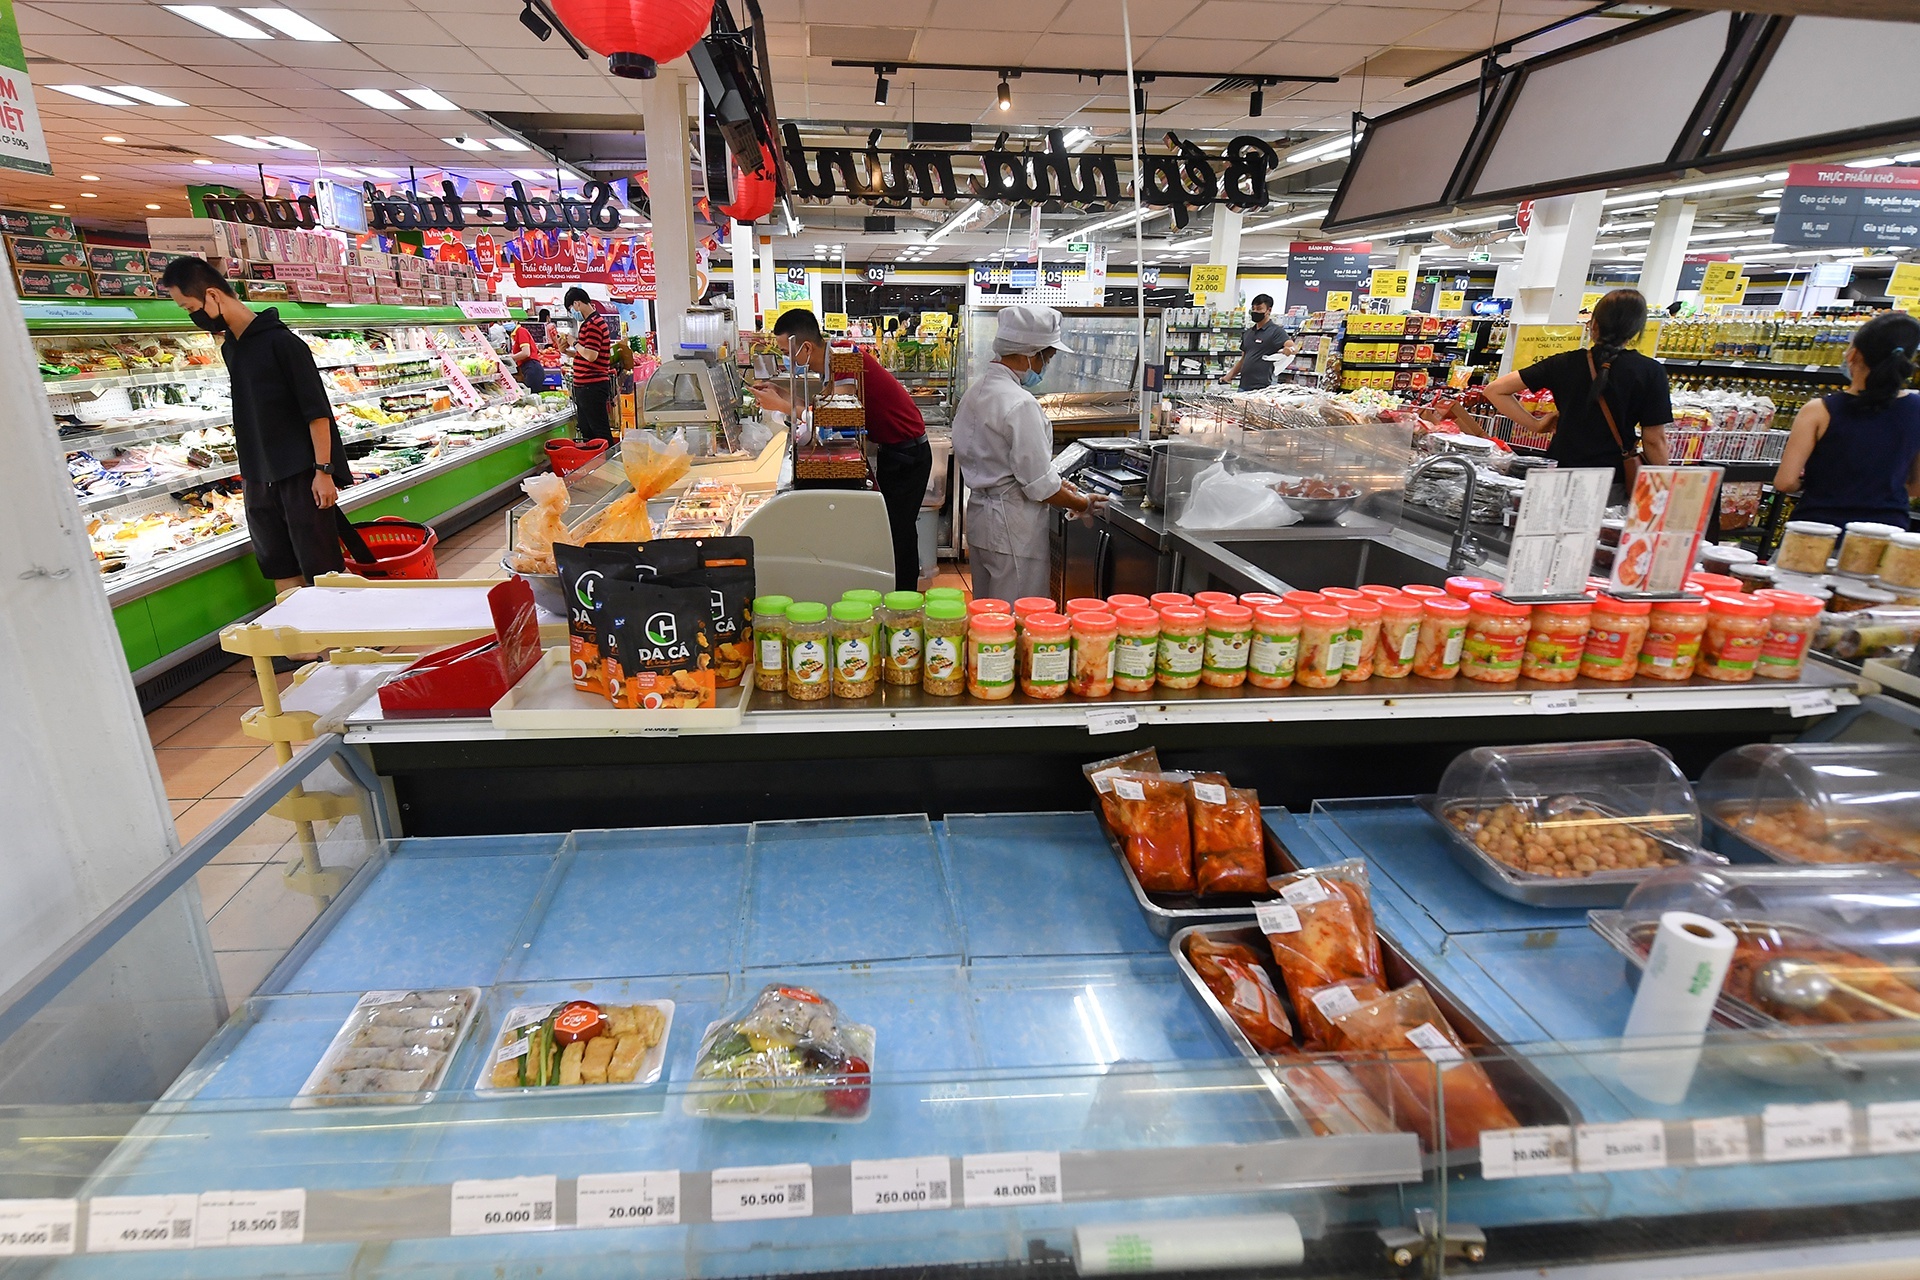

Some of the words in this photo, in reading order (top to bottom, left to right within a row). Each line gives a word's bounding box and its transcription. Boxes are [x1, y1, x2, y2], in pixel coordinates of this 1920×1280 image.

[12, 138, 28, 150] 500g
[755, 162, 776, 181] Su
[1818, 171, 1843, 184] THỰC
[1844, 170, 1871, 182] PHẨM
[1872, 172, 1894, 184] KHÔ
[1800, 195, 1816, 204] Gạo
[1817, 195, 1830, 204] các
[1831, 196, 1847, 206] loại
[521, 261, 536, 272] Trái
[539, 262, 553, 274] cây
[554, 264, 572, 272] New
[788, 268, 804, 279] 02
[868, 269, 884, 280] 03
[975, 272, 990, 282] 04
[1046, 272, 1062, 282] 05
[1143, 272, 1156, 284] 06
[1455, 279, 1468, 290] 10
[639, 648, 665, 661] DA
[667, 642, 690, 659] CÁ
[876, 1190, 927, 1204] 260.000
[993, 1185, 1036, 1197] 48.000
[740, 1192, 785, 1206] 50.500
[484, 1210, 530, 1224] 60.000
[609, 1206, 653, 1219] 20.000
[229, 1218, 277, 1232] 18.500
